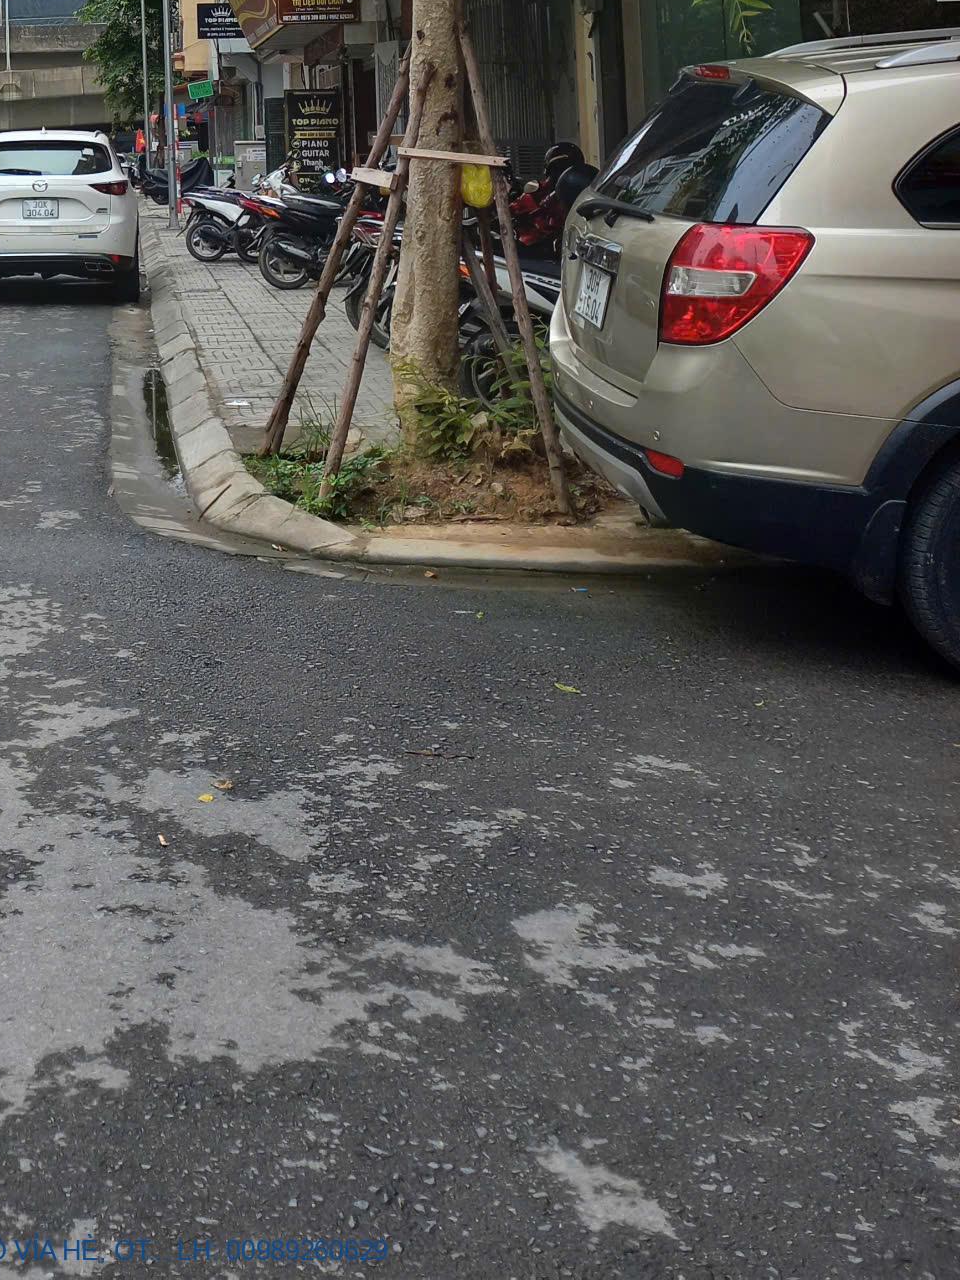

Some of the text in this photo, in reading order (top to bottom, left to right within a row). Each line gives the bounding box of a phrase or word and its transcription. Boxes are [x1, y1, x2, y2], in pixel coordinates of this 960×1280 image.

[301, 140, 329, 148] PIANO
[301, 149, 330, 158] GUITAR
[26, 209, 55, 217] 304.04
